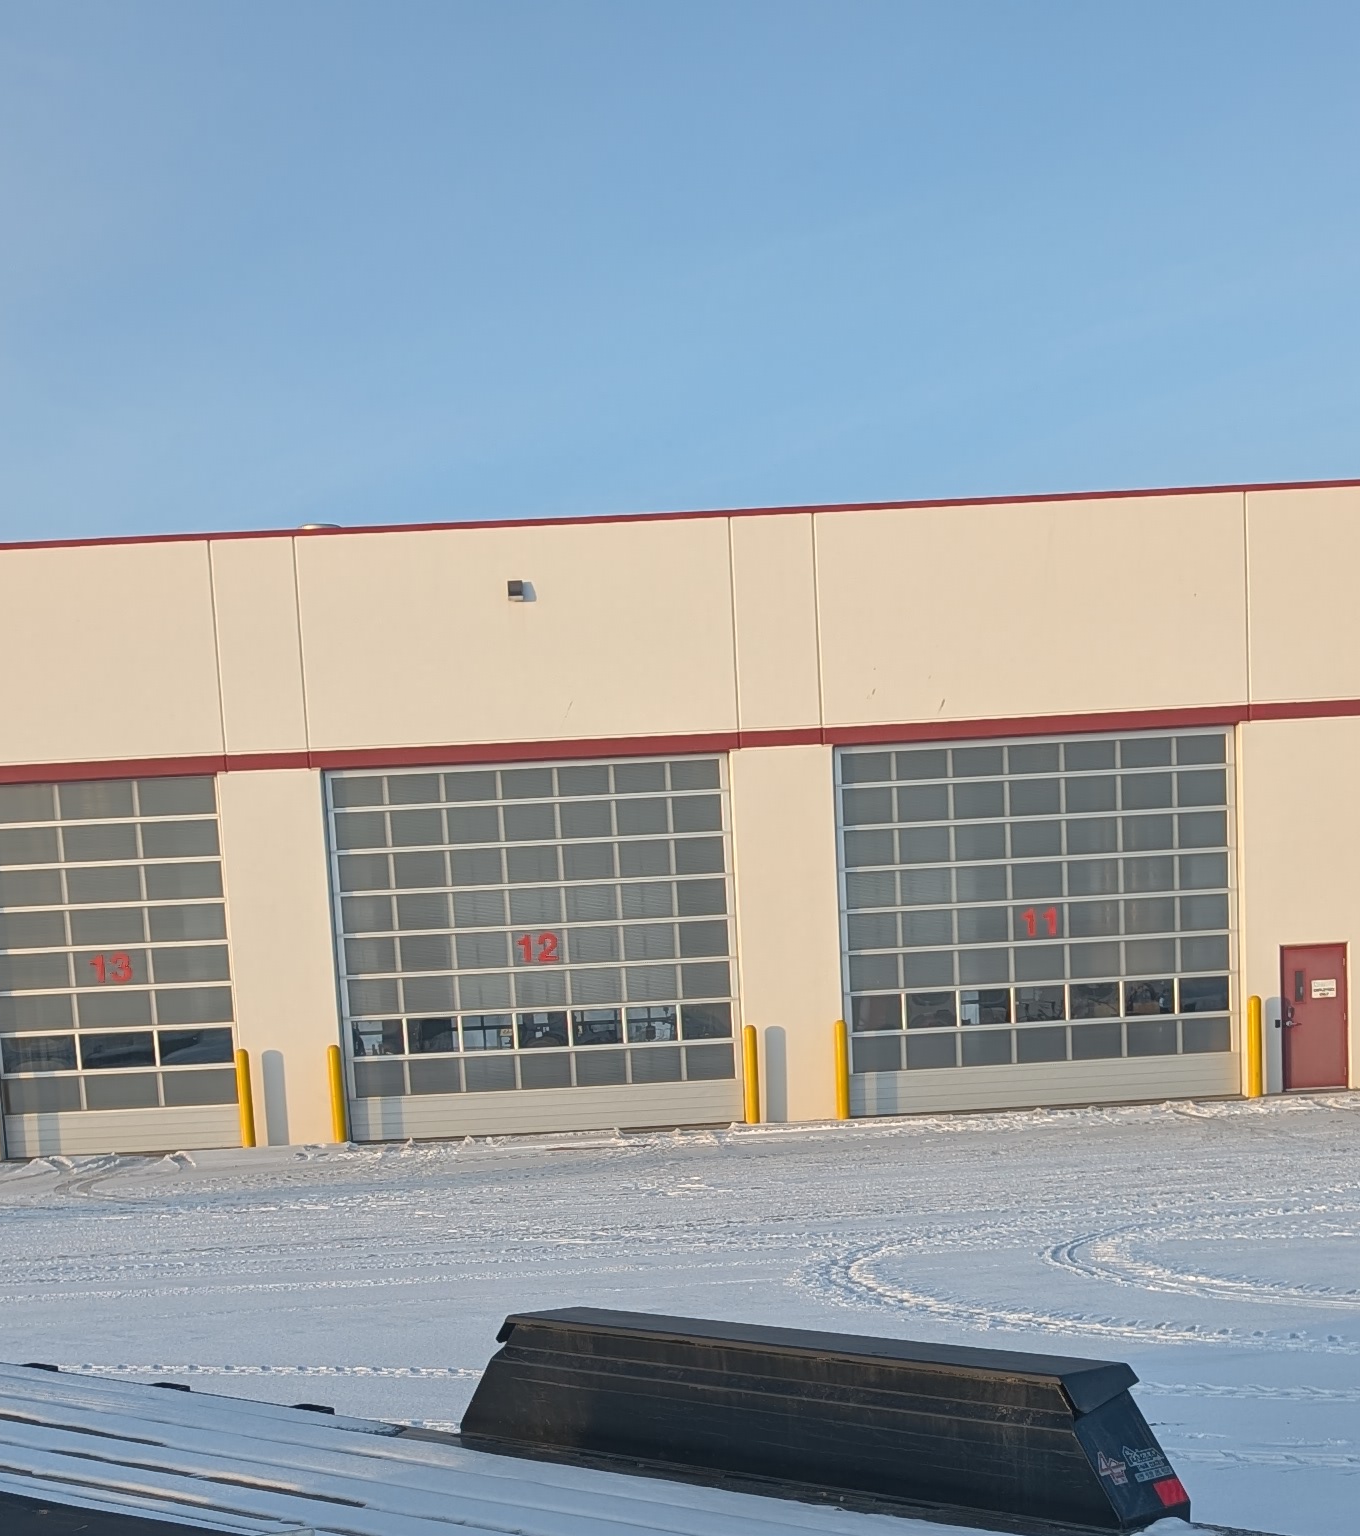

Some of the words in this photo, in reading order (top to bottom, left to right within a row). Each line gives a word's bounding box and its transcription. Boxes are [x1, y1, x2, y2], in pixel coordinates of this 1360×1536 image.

[1021, 906, 1058, 937] 11
[517, 931, 559, 963] 12
[89, 951, 133, 983] 13
